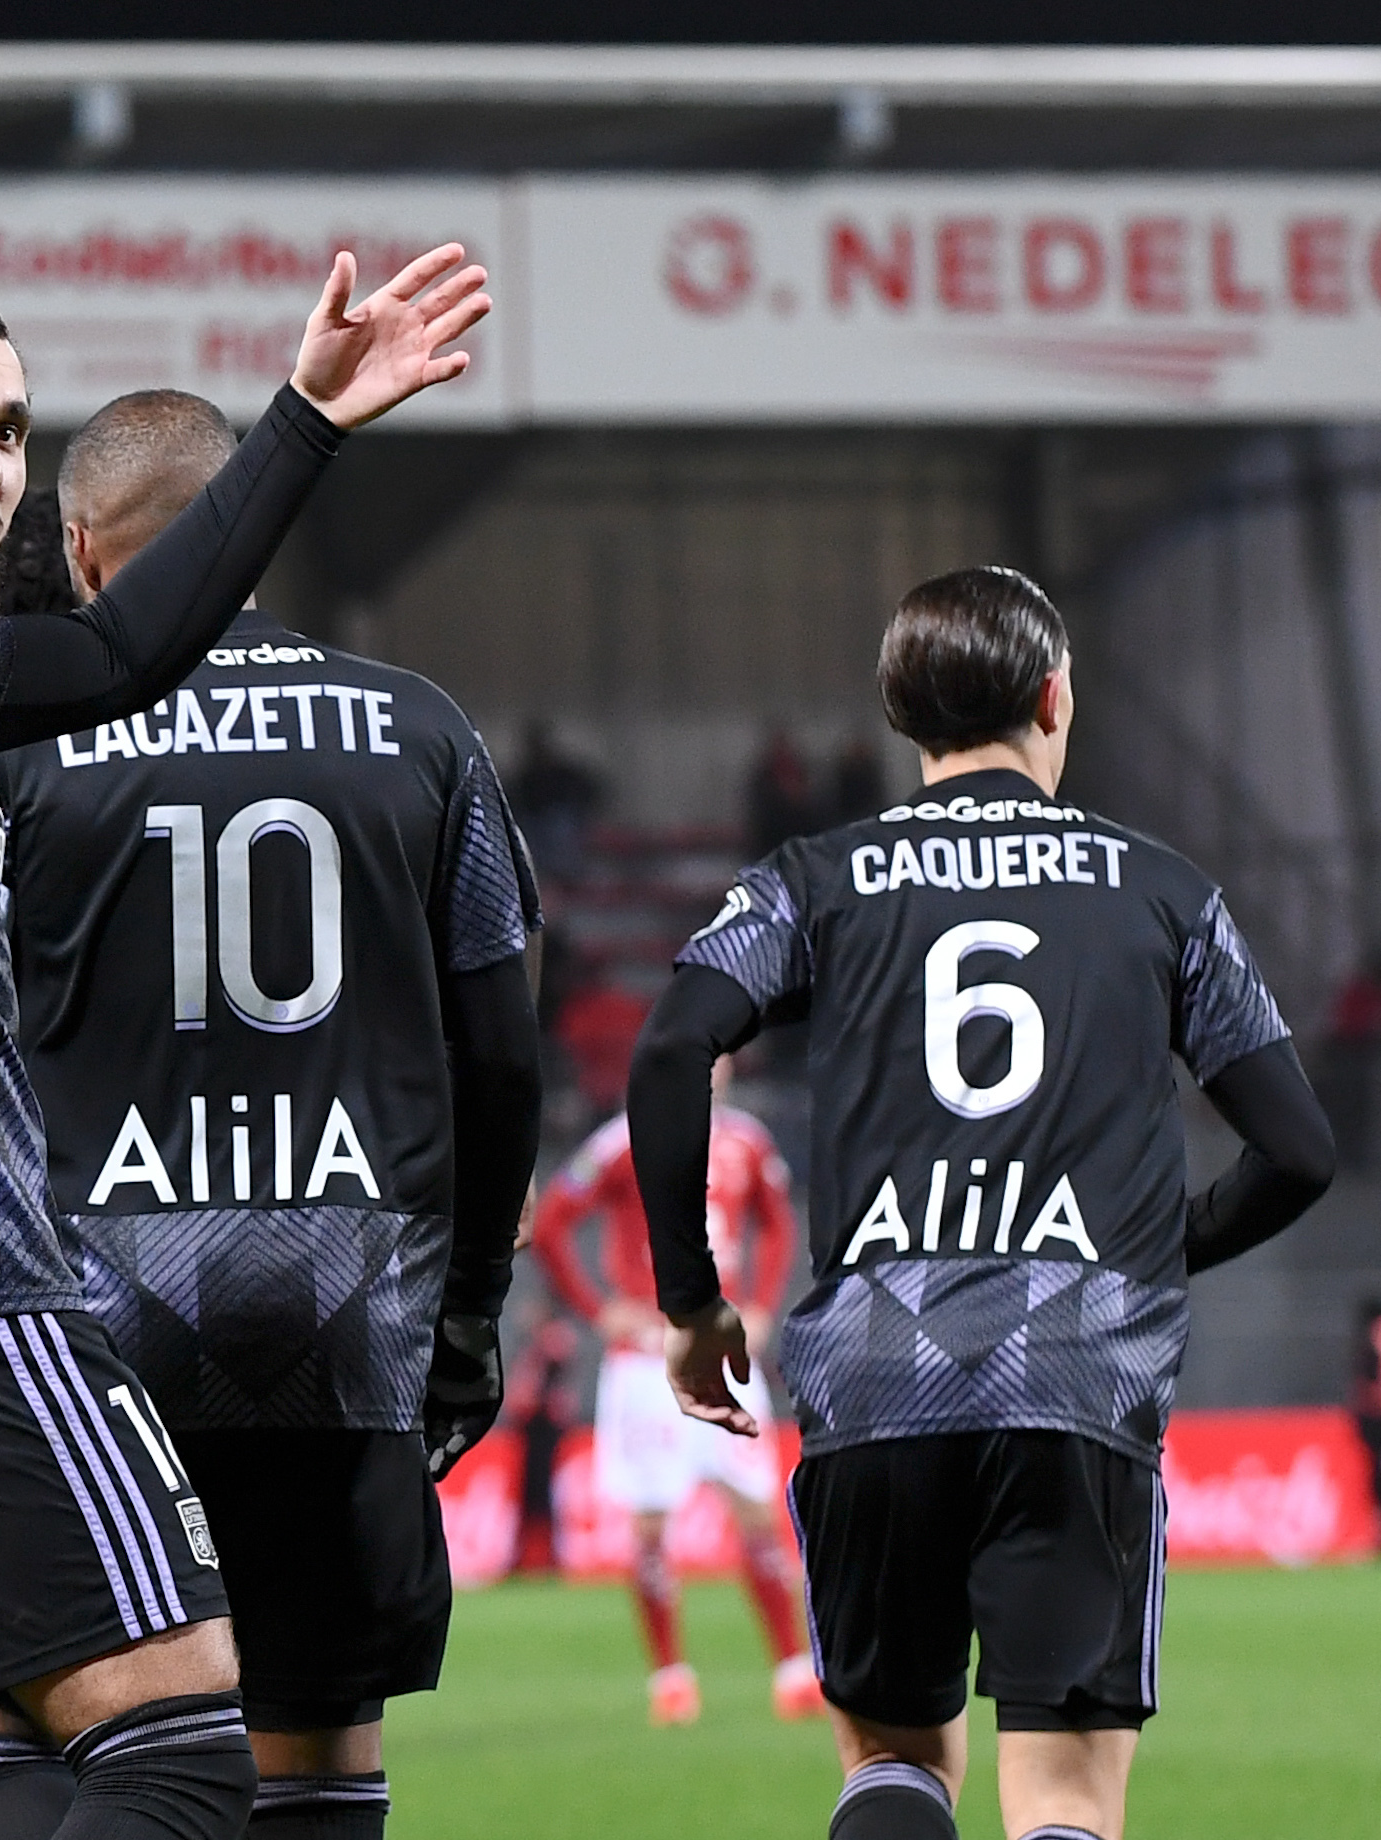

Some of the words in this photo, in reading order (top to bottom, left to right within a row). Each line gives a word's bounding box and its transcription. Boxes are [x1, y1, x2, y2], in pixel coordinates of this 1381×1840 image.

[828, 214, 1381, 316] NEDELE
[202, 643, 325, 667] arden
[57, 684, 400, 768] LACAZETTE
[851, 832, 1129, 895] CAQUERET
[144, 798, 344, 1033] 10
[924, 920, 1045, 1120] 6
